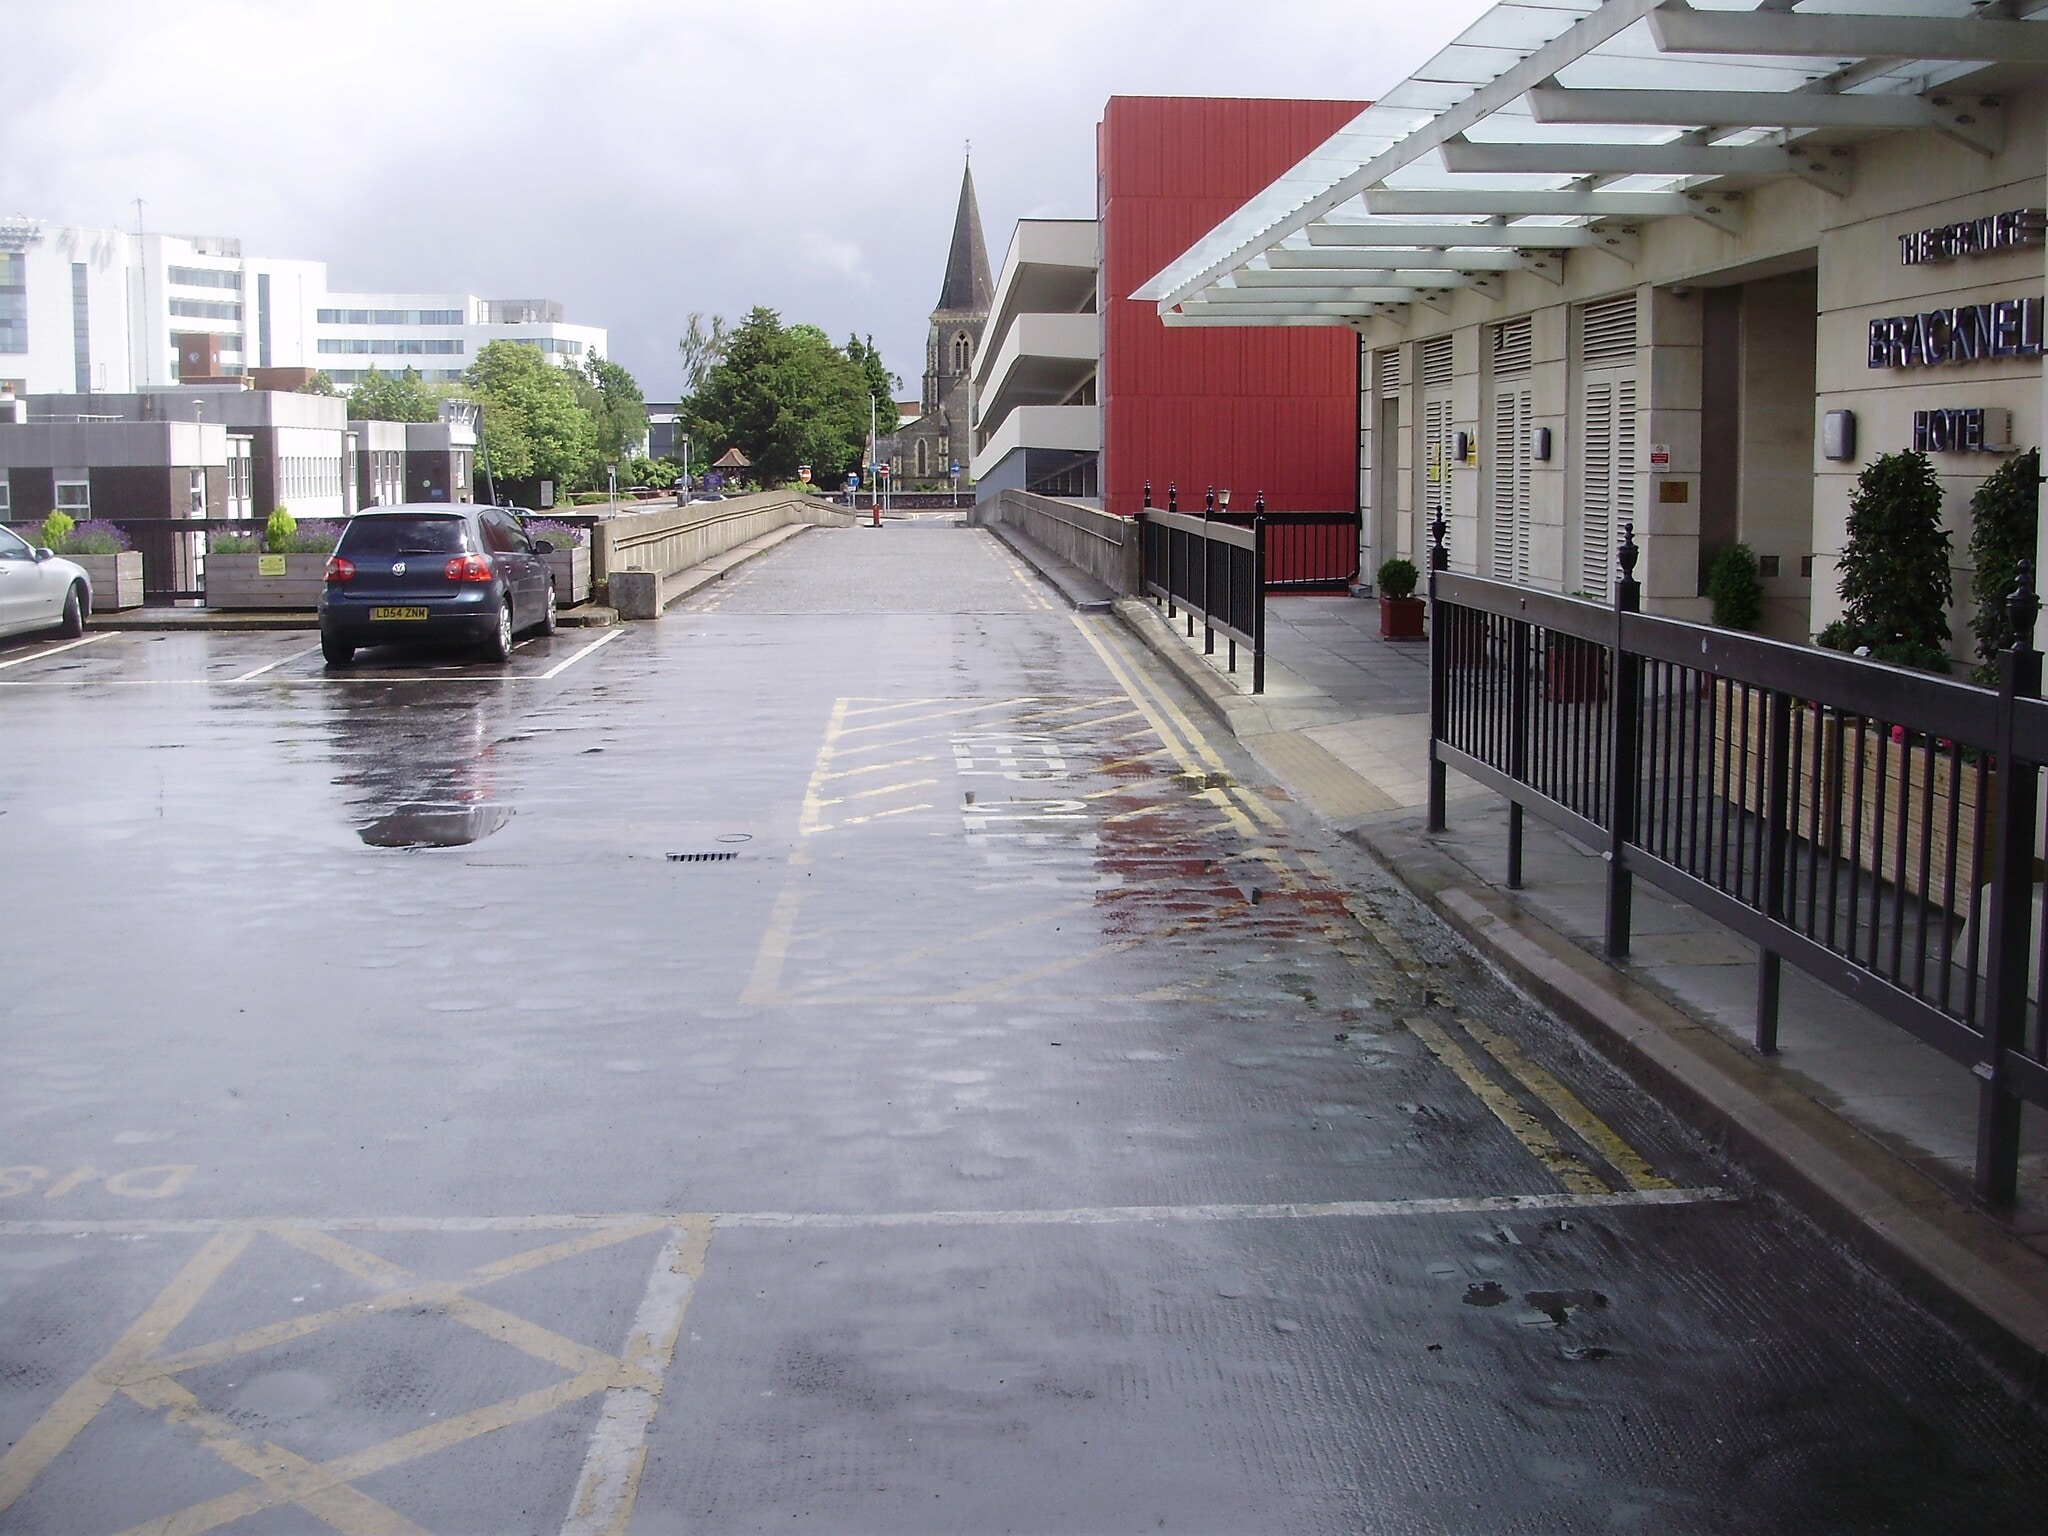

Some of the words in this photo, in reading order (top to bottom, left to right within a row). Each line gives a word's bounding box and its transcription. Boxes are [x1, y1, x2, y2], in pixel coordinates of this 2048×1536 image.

[1898, 227, 1935, 265] THE
[1941, 208, 2029, 256] GRANGE
[1911, 407, 2020, 452] HOTEL
[376, 608, 402, 618] LD54
[949, 731, 1070, 781] KEEP
[959, 800, 1123, 890] CLEAR
